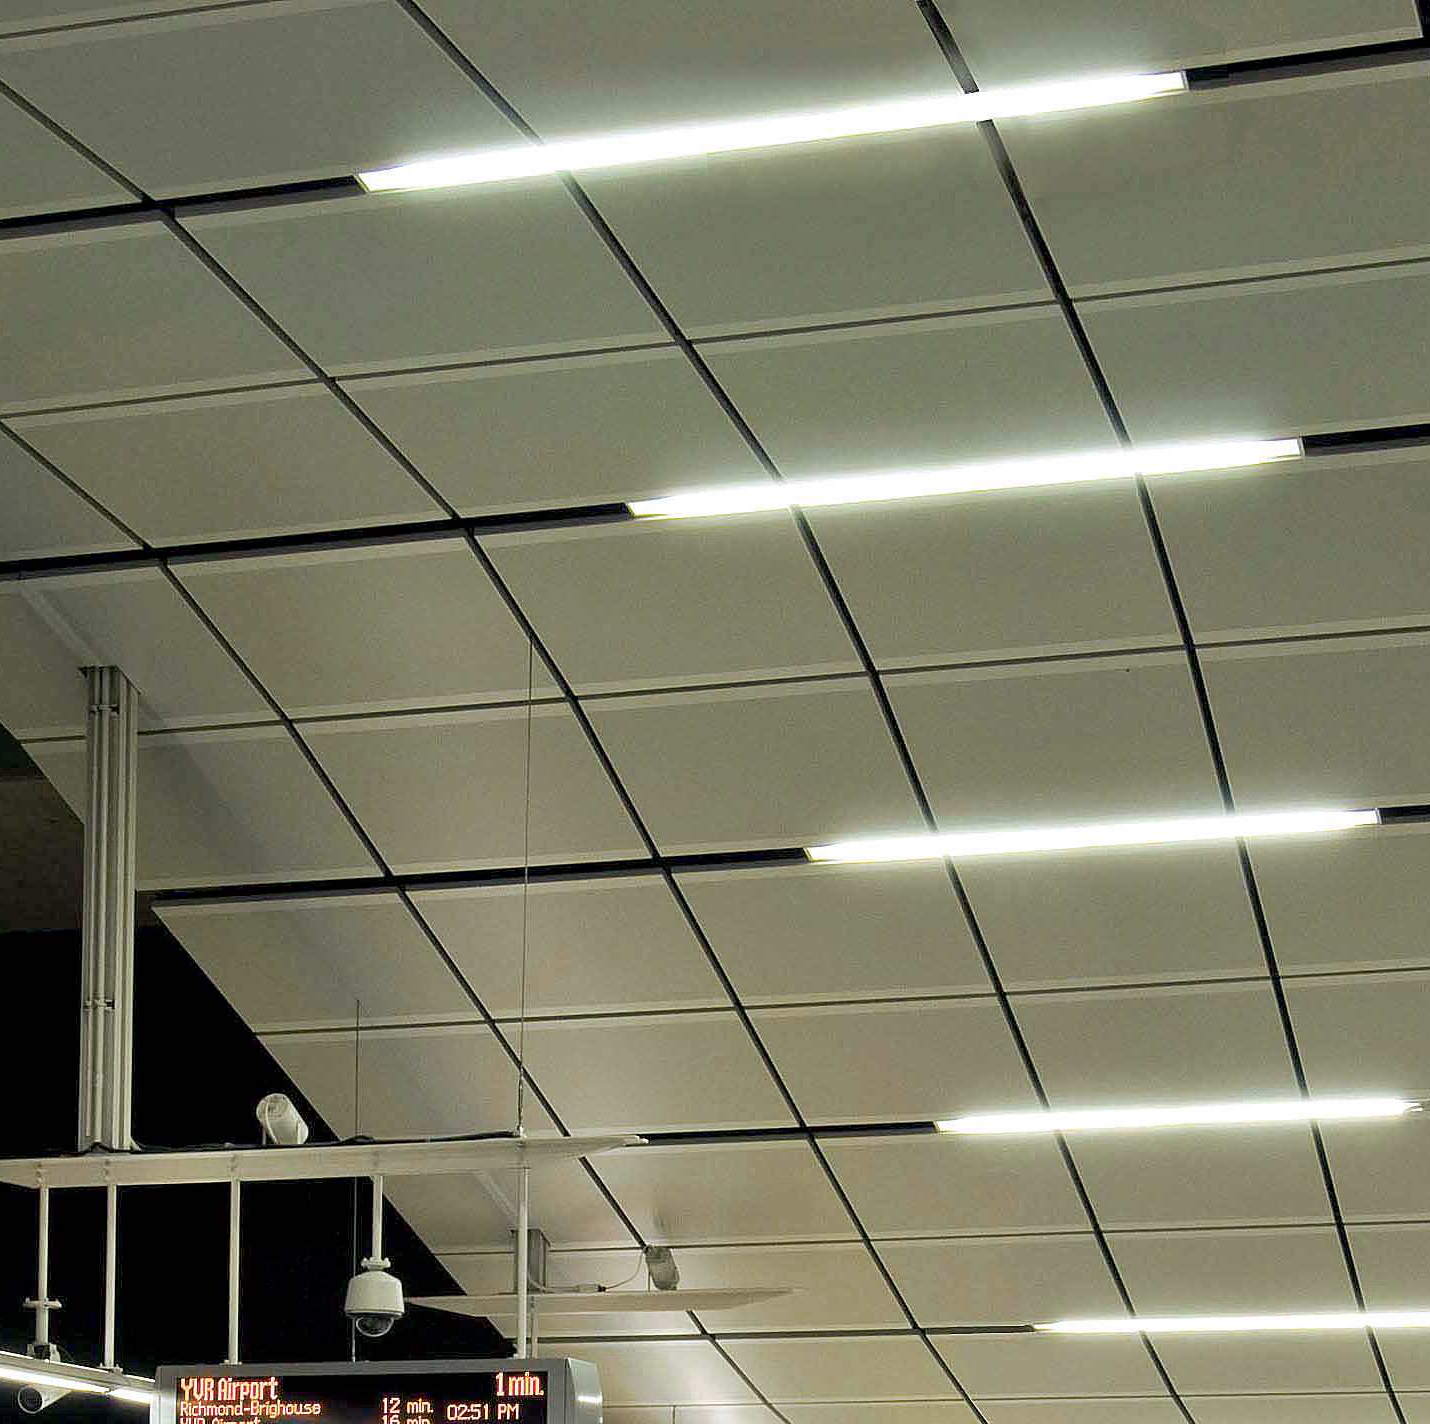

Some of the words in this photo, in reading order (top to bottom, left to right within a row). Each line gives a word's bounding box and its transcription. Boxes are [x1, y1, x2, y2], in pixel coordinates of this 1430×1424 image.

[180, 1377, 214, 1400] YVR
[217, 1376, 278, 1400] Airport
[495, 1372, 505, 1396] 1
[508, 1371, 544, 1396] min.
[179, 1400, 321, 1418] Richmond-Brighouse
[382, 1397, 400, 1414] 12
[406, 1398, 434, 1414] min.
[446, 1403, 489, 1420] 02:51
[497, 1403, 519, 1420] PM
